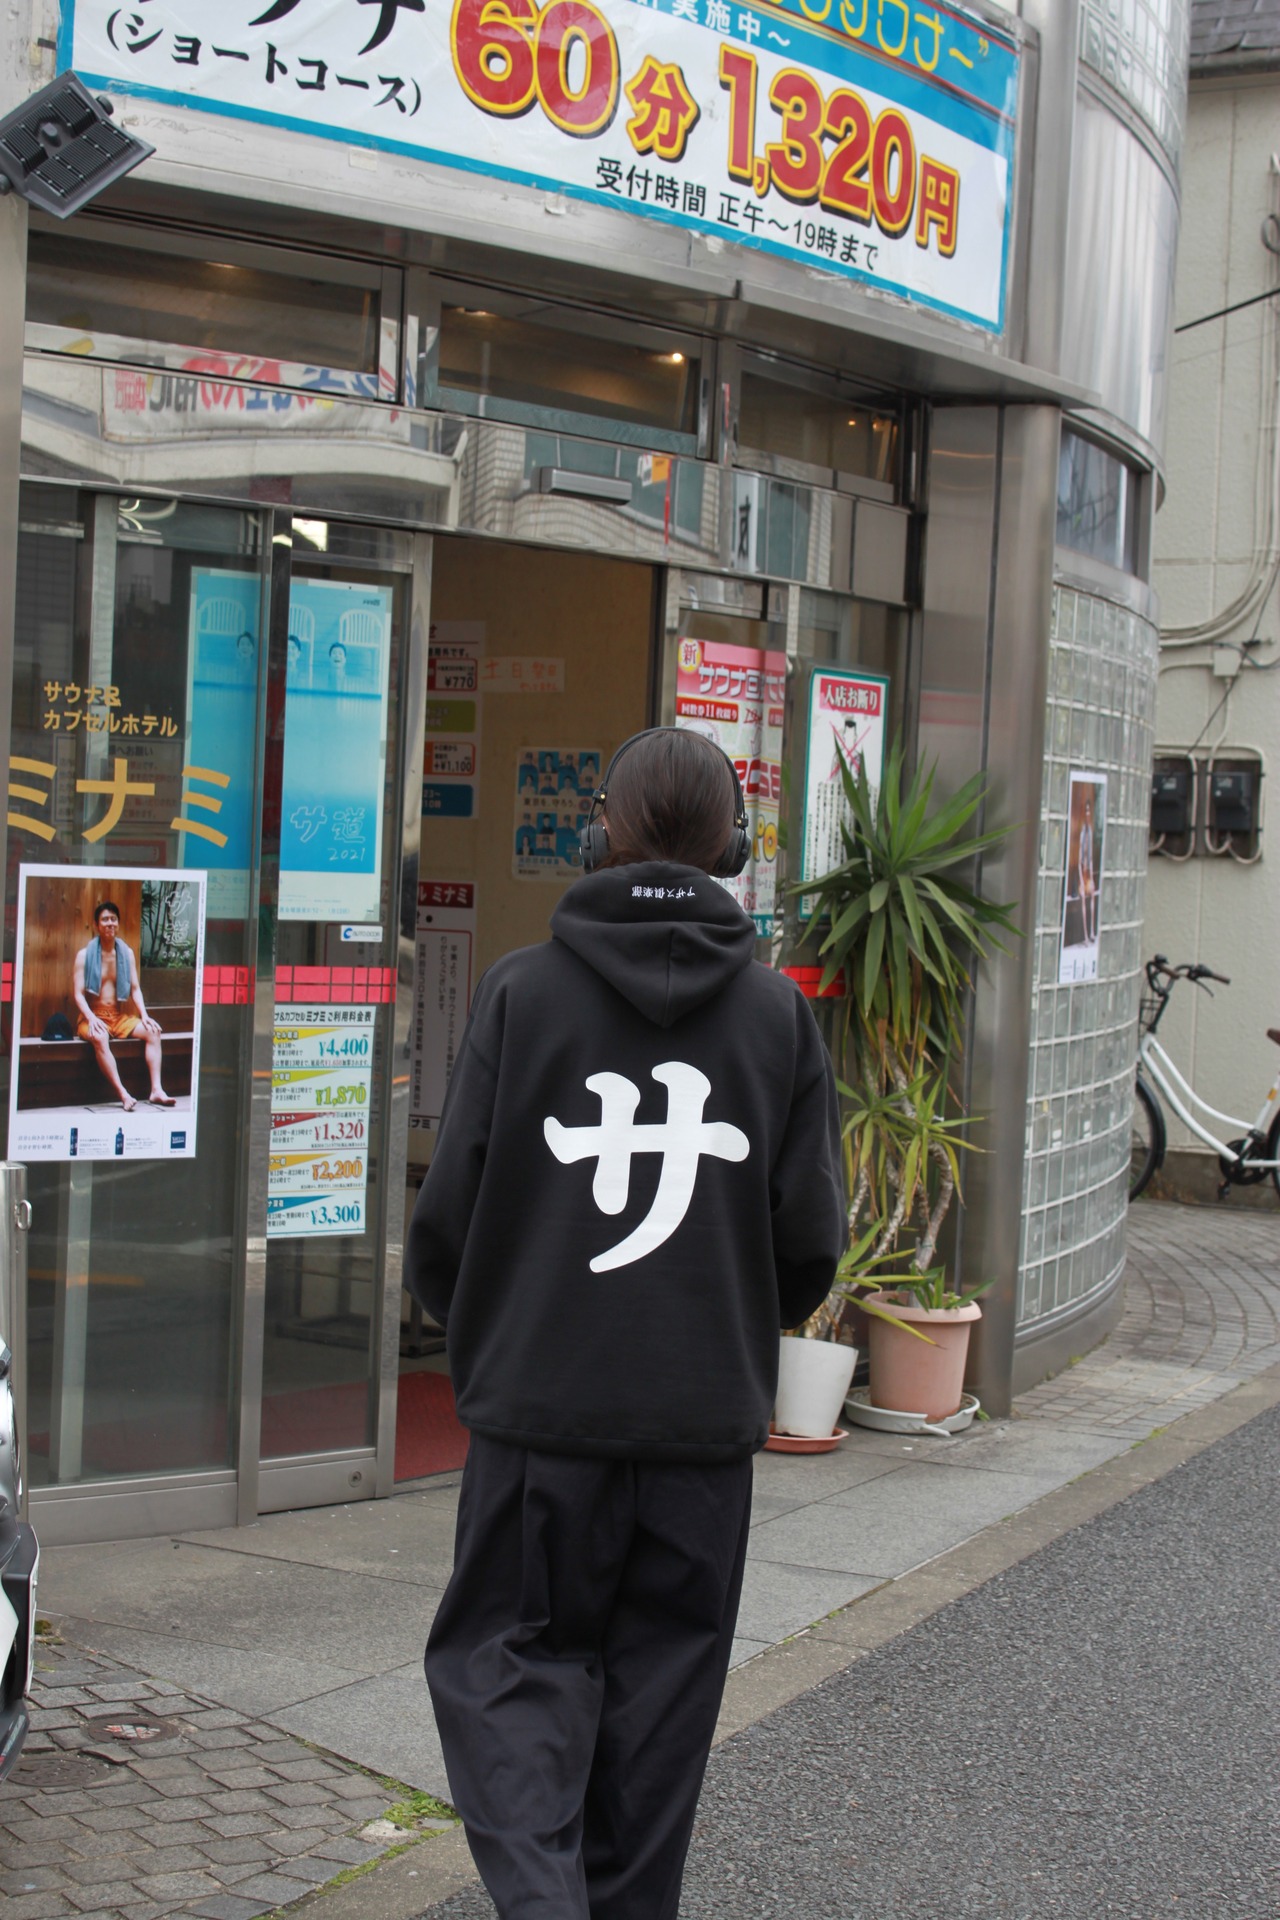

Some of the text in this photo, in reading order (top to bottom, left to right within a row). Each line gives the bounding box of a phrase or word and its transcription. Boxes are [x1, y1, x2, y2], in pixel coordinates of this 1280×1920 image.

[718, 42, 960, 260] 1,320円
[595, 157, 707, 218] 受付時間
[682, 643, 697, 666] 新
[824, 683, 878, 713] 入店お断り
[290, 805, 366, 843] サ道
[328, 847, 366, 861] 2021
[432, 888, 468, 904] ミナミ
[631, 885, 696, 900] アザス倶楽部
[306, 1010, 326, 1022] ミナミ
[327, 1010, 372, 1023] ご利用料金表
[319, 1037, 369, 1057] ¥4,400
[316, 1085, 367, 1107] ¥1,870
[314, 1121, 364, 1141] ¥1,320
[312, 1159, 363, 1181] ¥2,200
[543, 1061, 750, 1274] サ
[311, 1204, 361, 1225] ¥3,300
